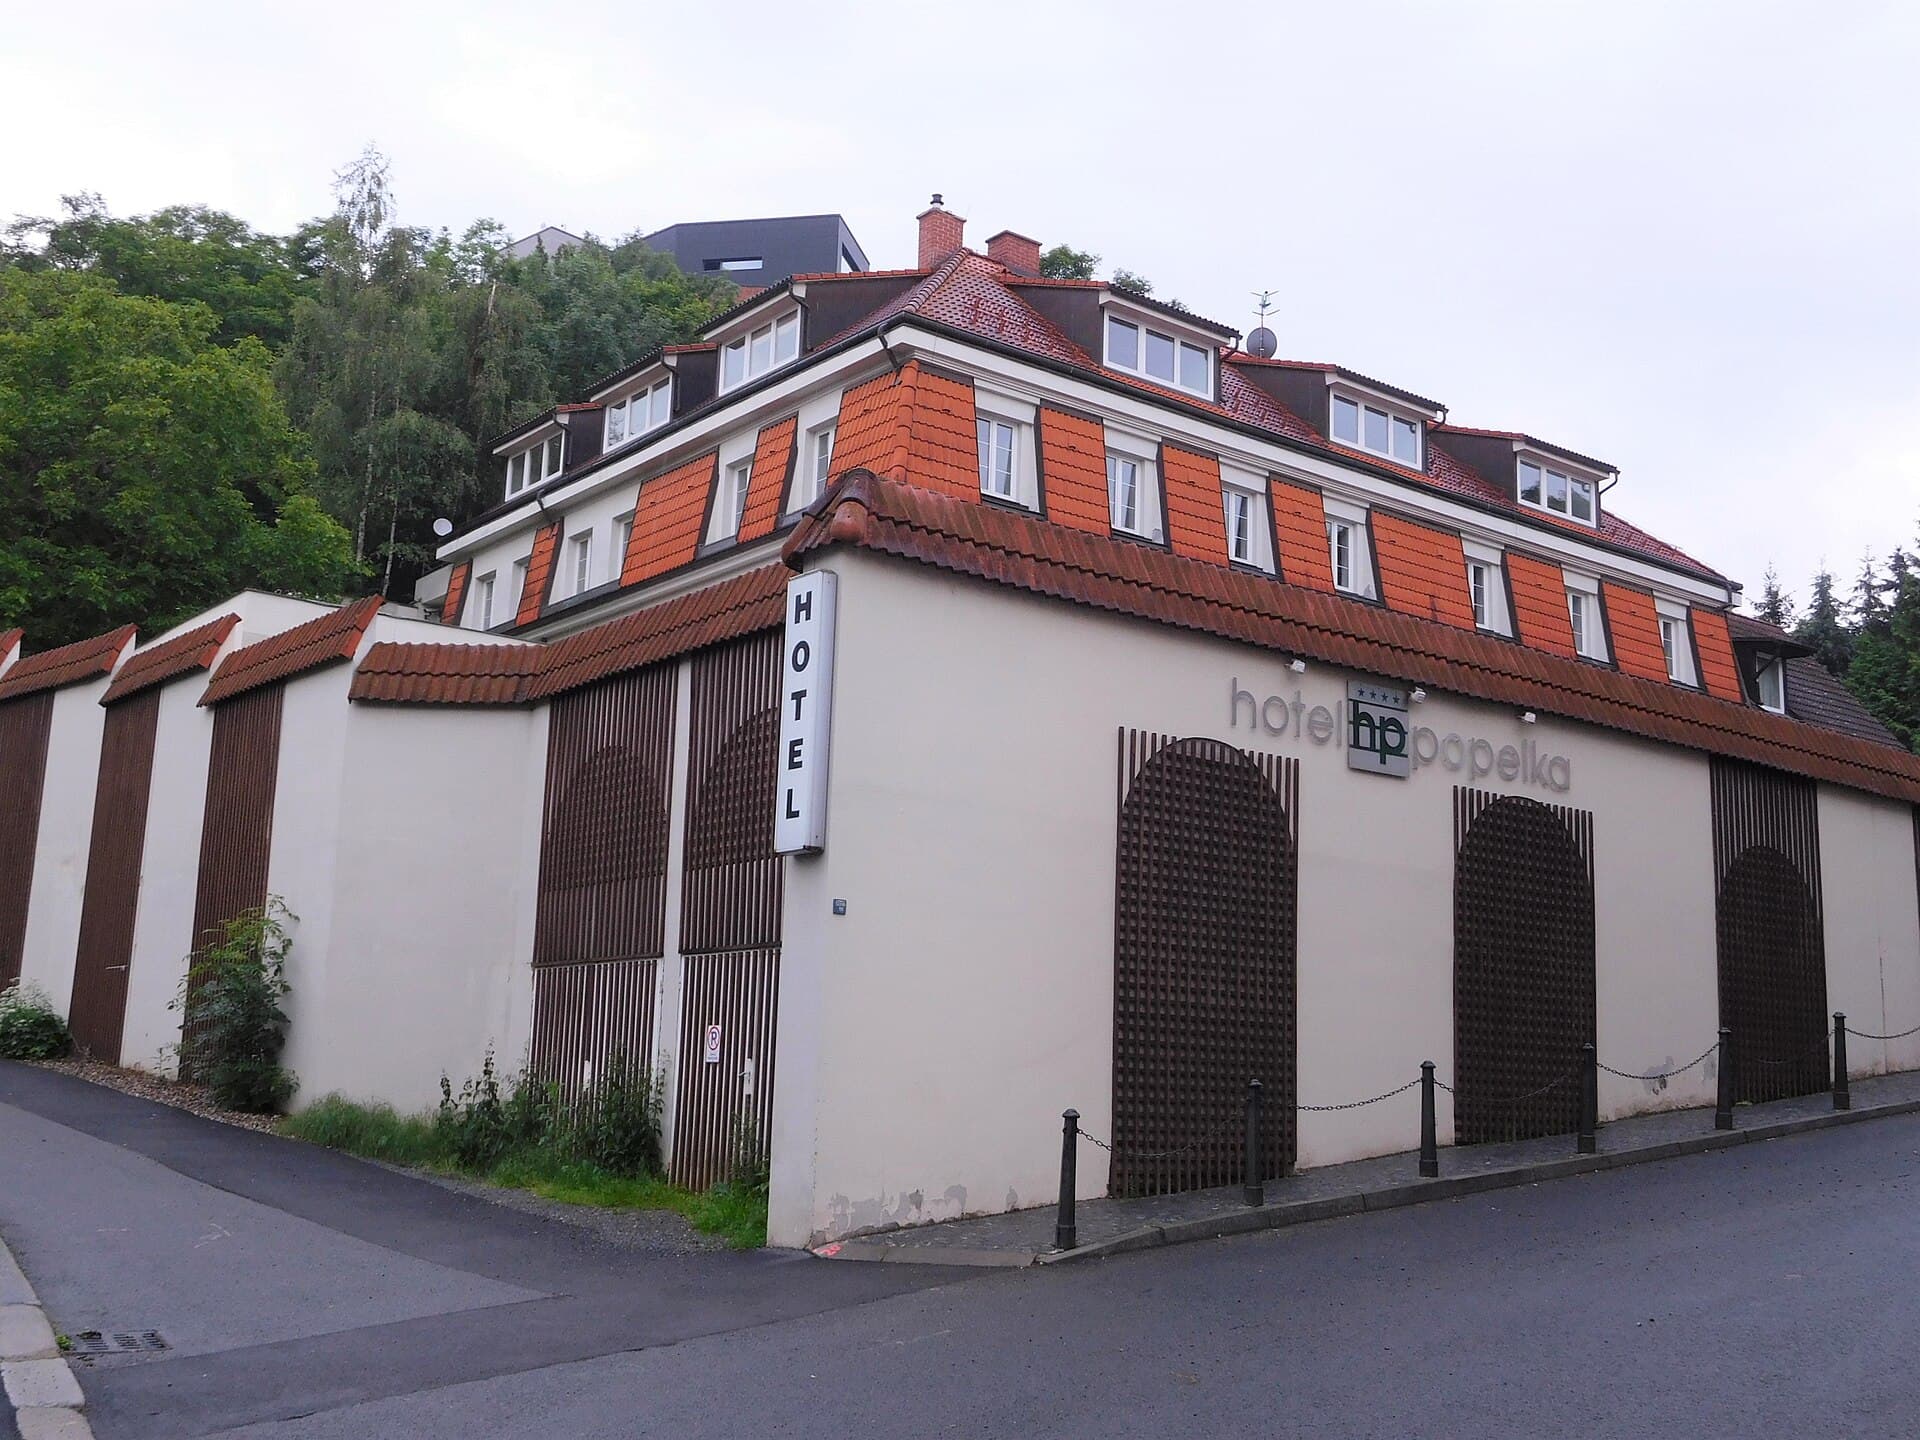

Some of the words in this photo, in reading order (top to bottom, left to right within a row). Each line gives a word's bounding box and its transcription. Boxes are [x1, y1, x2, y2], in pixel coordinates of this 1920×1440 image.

[785, 591, 812, 820] HOTEL
[1230, 677, 1342, 746] hotel
[1352, 700, 1406, 765] hp
[1411, 725, 1571, 792] popelka
